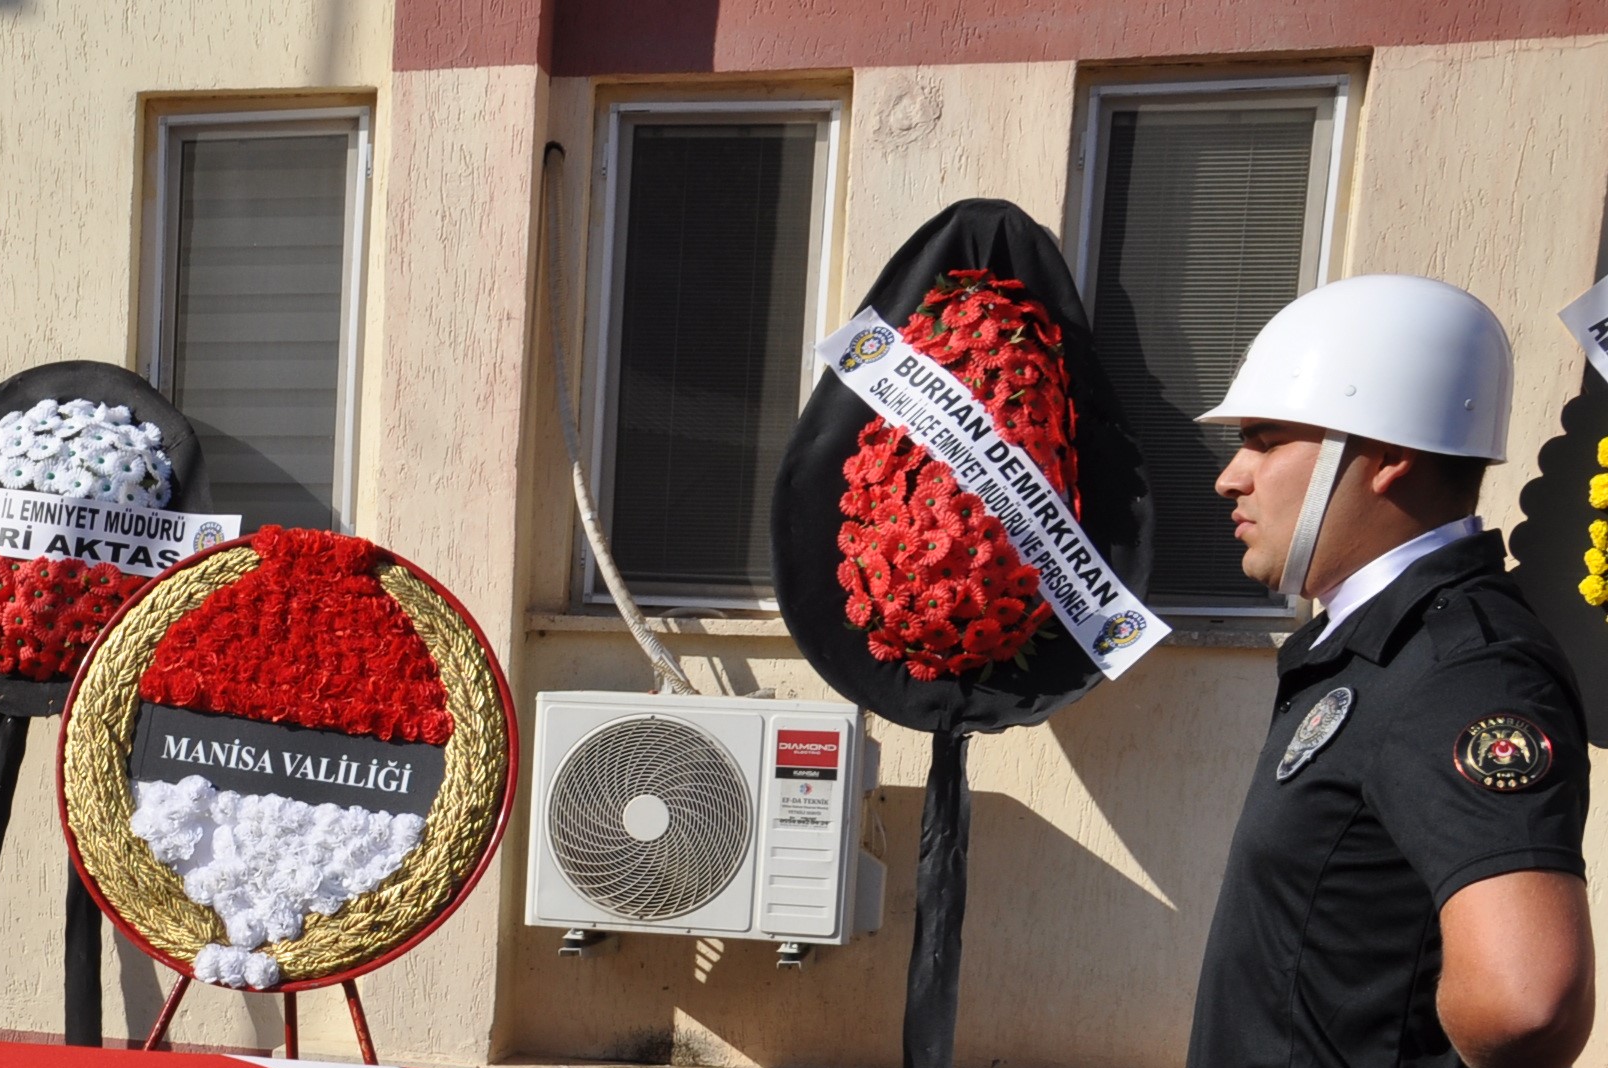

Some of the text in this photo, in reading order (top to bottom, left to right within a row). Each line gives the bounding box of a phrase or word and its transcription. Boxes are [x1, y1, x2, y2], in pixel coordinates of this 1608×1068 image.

[869, 377, 923, 418] SALİHLİ
[906, 402, 942, 437] İLÇE
[893, 355, 1119, 607] BURHAN DEMİRKIRAN
[929, 427, 988, 483] EMNİYET
[1, 492, 15, 519] İL
[19, 497, 100, 530] EMNİYET
[104, 508, 186, 543] MÜDÜRÜ
[975, 478, 1034, 538] MÜDÜRÜ
[1019, 530, 1044, 558] VE
[1031, 550, 1099, 626] PERSONELİ
[161, 734, 413, 794] MANİSA VALİLİĞİ
[778, 742, 838, 752] DIAMOND
